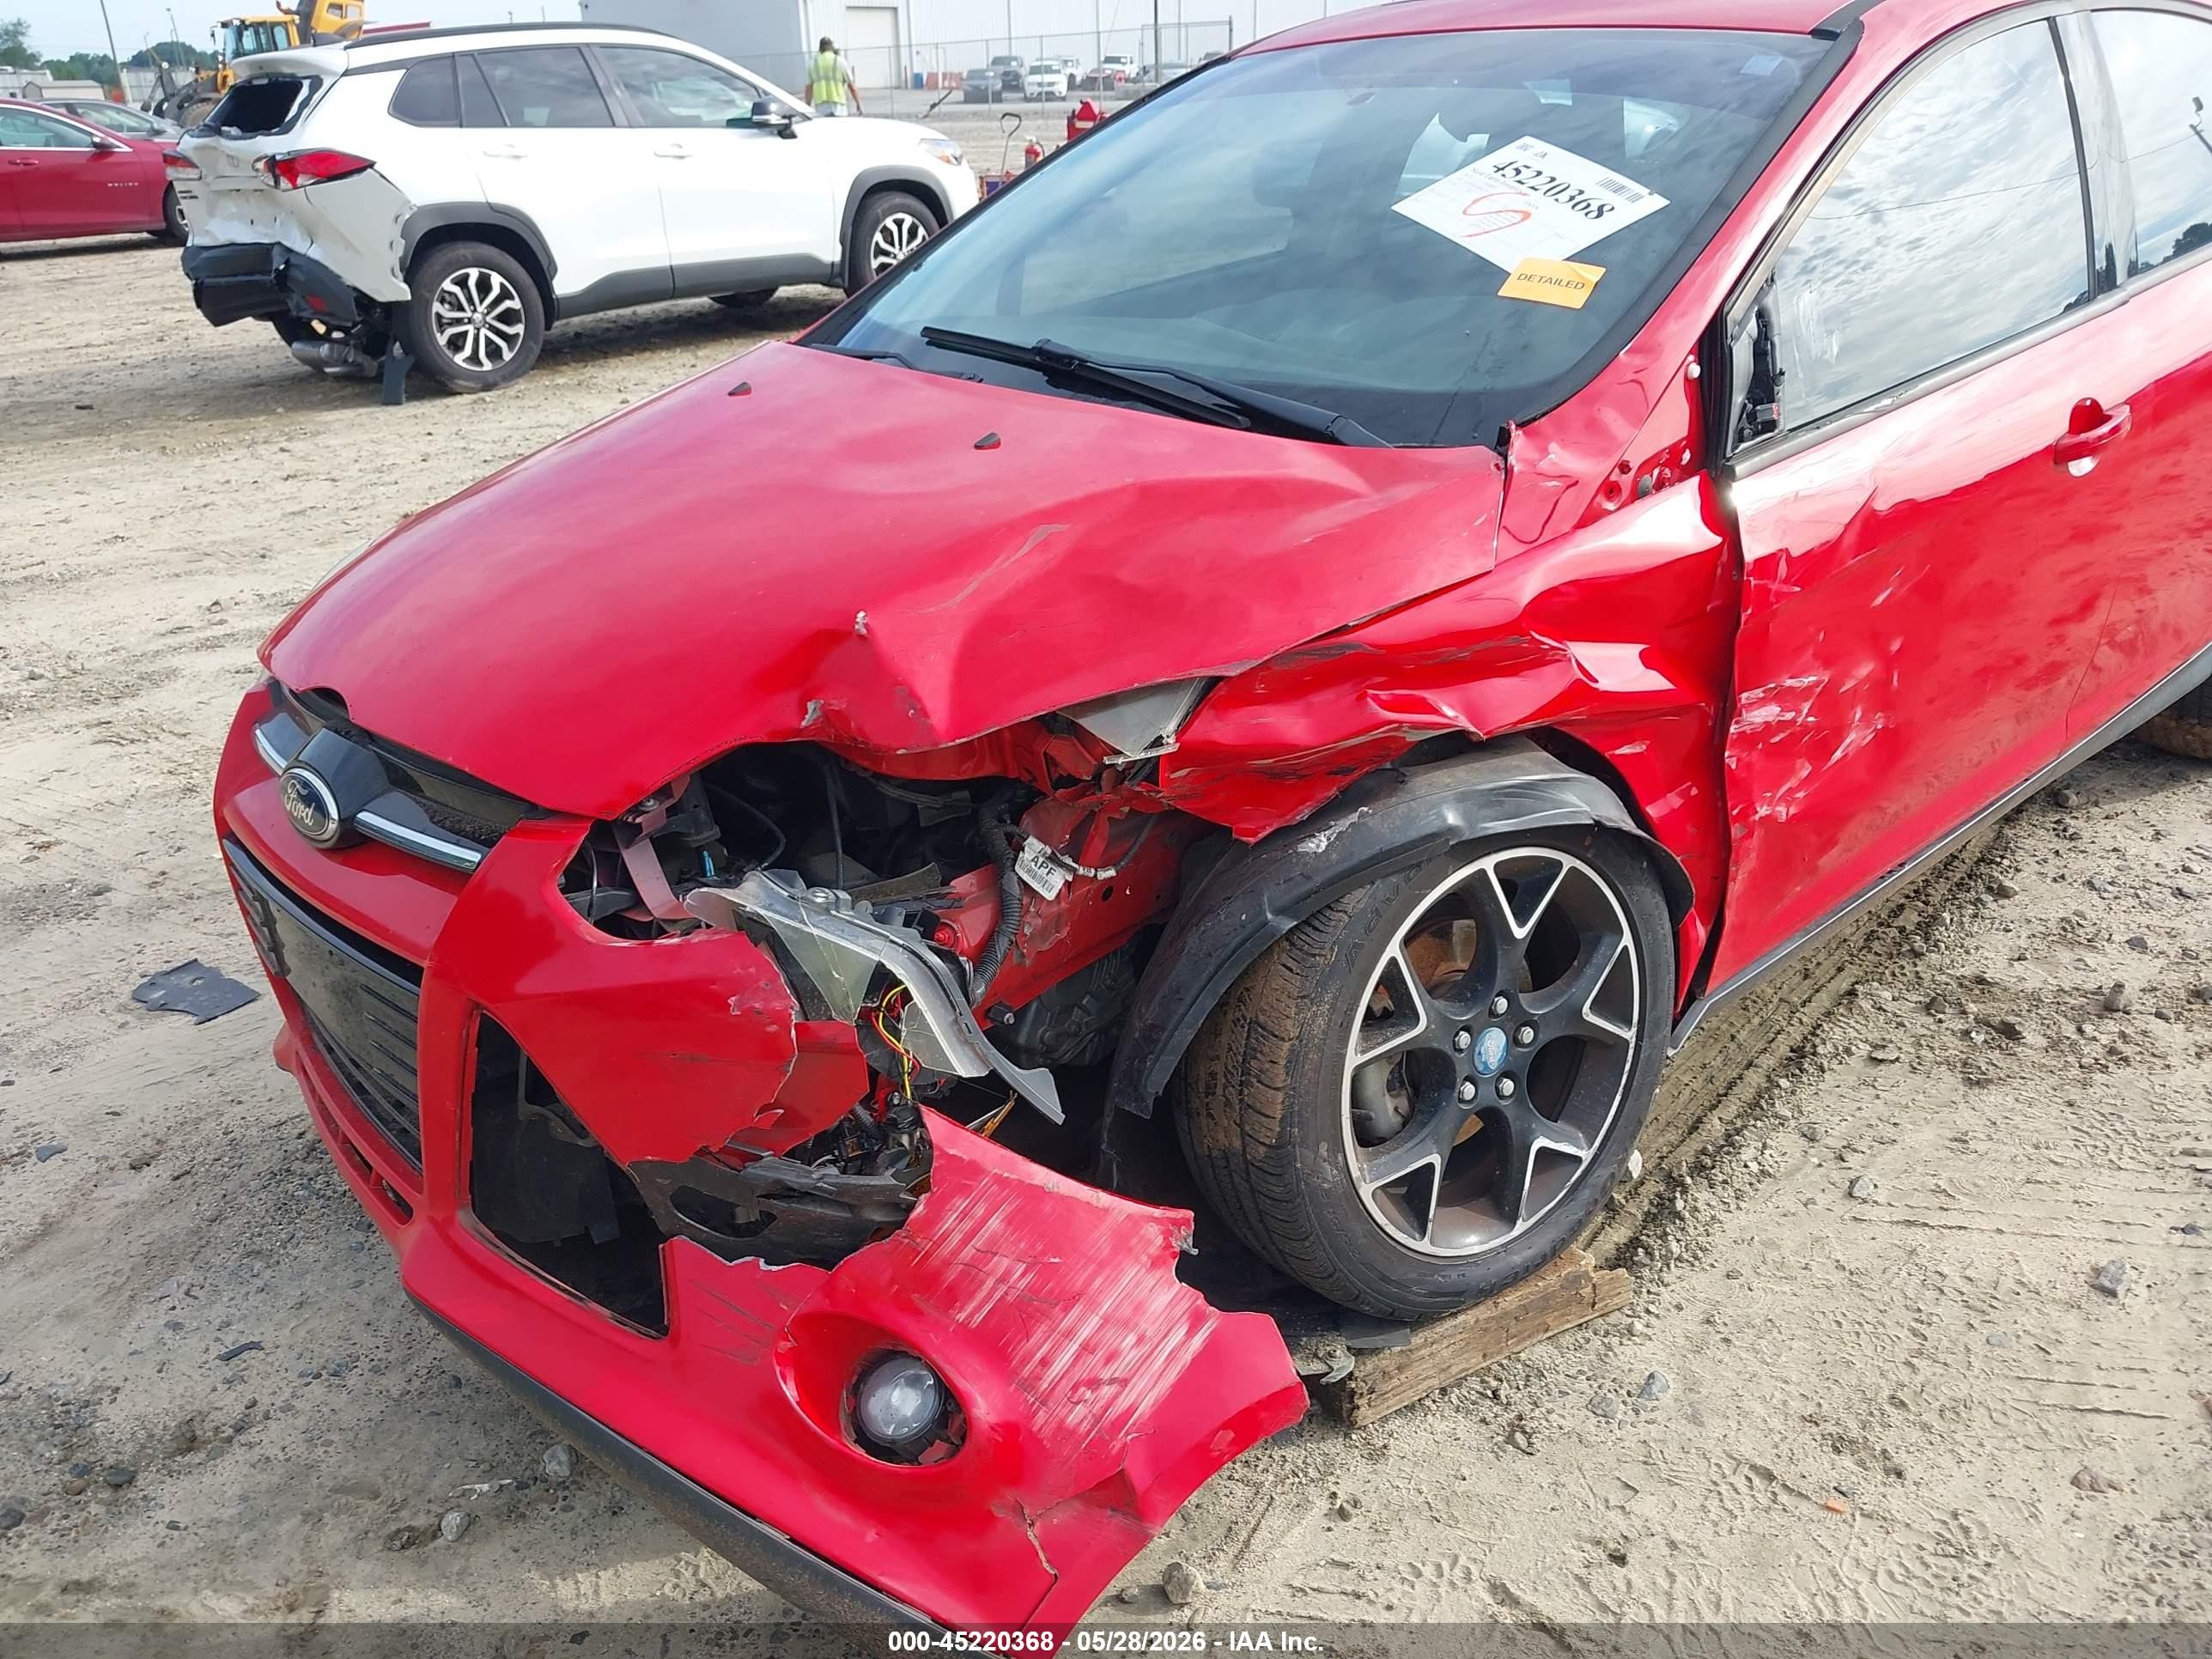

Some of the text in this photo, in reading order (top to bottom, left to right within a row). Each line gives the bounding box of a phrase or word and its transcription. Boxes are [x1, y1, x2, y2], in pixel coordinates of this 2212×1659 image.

[1492, 161, 1614, 219] 45220368
[1516, 273, 1585, 290] DETAILED
[284, 779, 316, 826] Ford
[1030, 854, 1057, 877] APF
